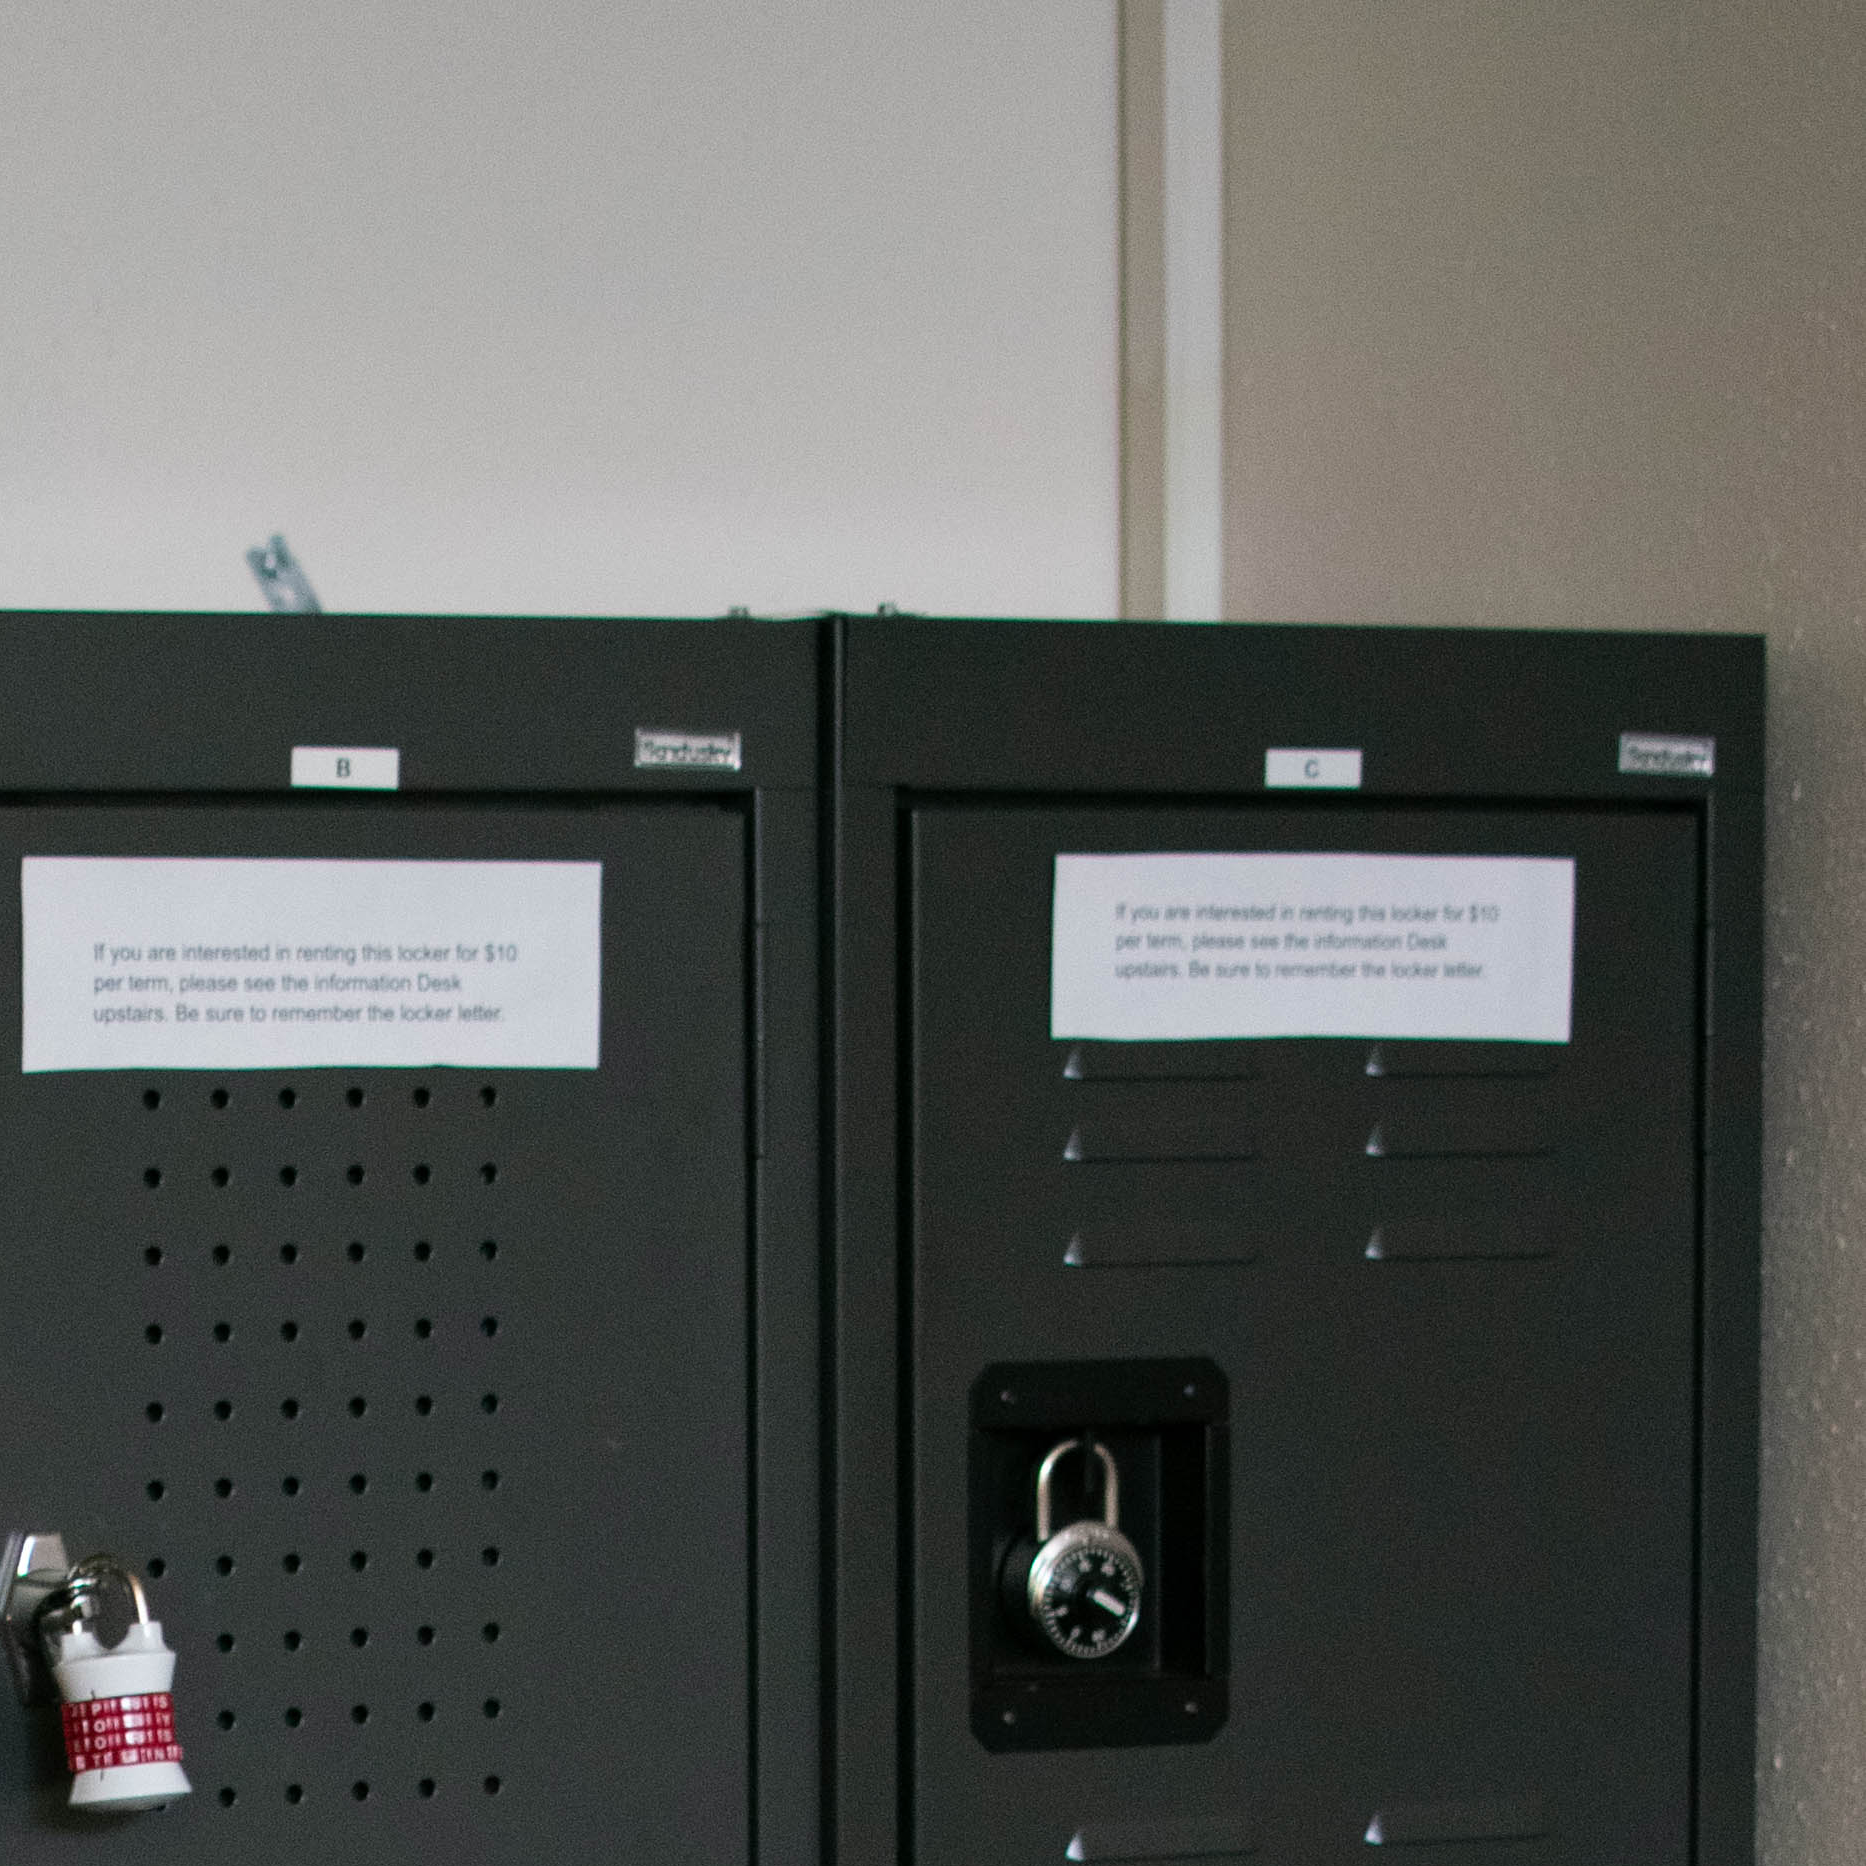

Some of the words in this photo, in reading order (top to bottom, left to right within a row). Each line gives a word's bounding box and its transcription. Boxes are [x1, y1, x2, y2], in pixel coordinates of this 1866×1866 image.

[336, 757, 351, 778] B
[1305, 759, 1320, 778] C
[92, 943, 105, 961] If
[109, 948, 143, 965] you
[146, 948, 178, 961] are
[180, 943, 271, 961] interested
[274, 943, 292, 961] in
[295, 943, 357, 965] renting
[361, 943, 393, 961] this
[396, 943, 450, 961] locker
[454, 943, 478, 961] for
[483, 943, 518, 963] $10
[93, 978, 124, 995] per
[178, 973, 238, 995] please
[243, 978, 276, 991] see
[280, 973, 309, 991] the
[416, 973, 462, 990] Desk
[92, 1004, 167, 1025] upstairs.
[174, 1004, 199, 1021] Be
[204, 1009, 244, 1021] sure
[249, 1006, 267, 1021] to
[271, 1003, 362, 1021] remember
[366, 1003, 395, 1021] the
[399, 1003, 452, 1021] locker
